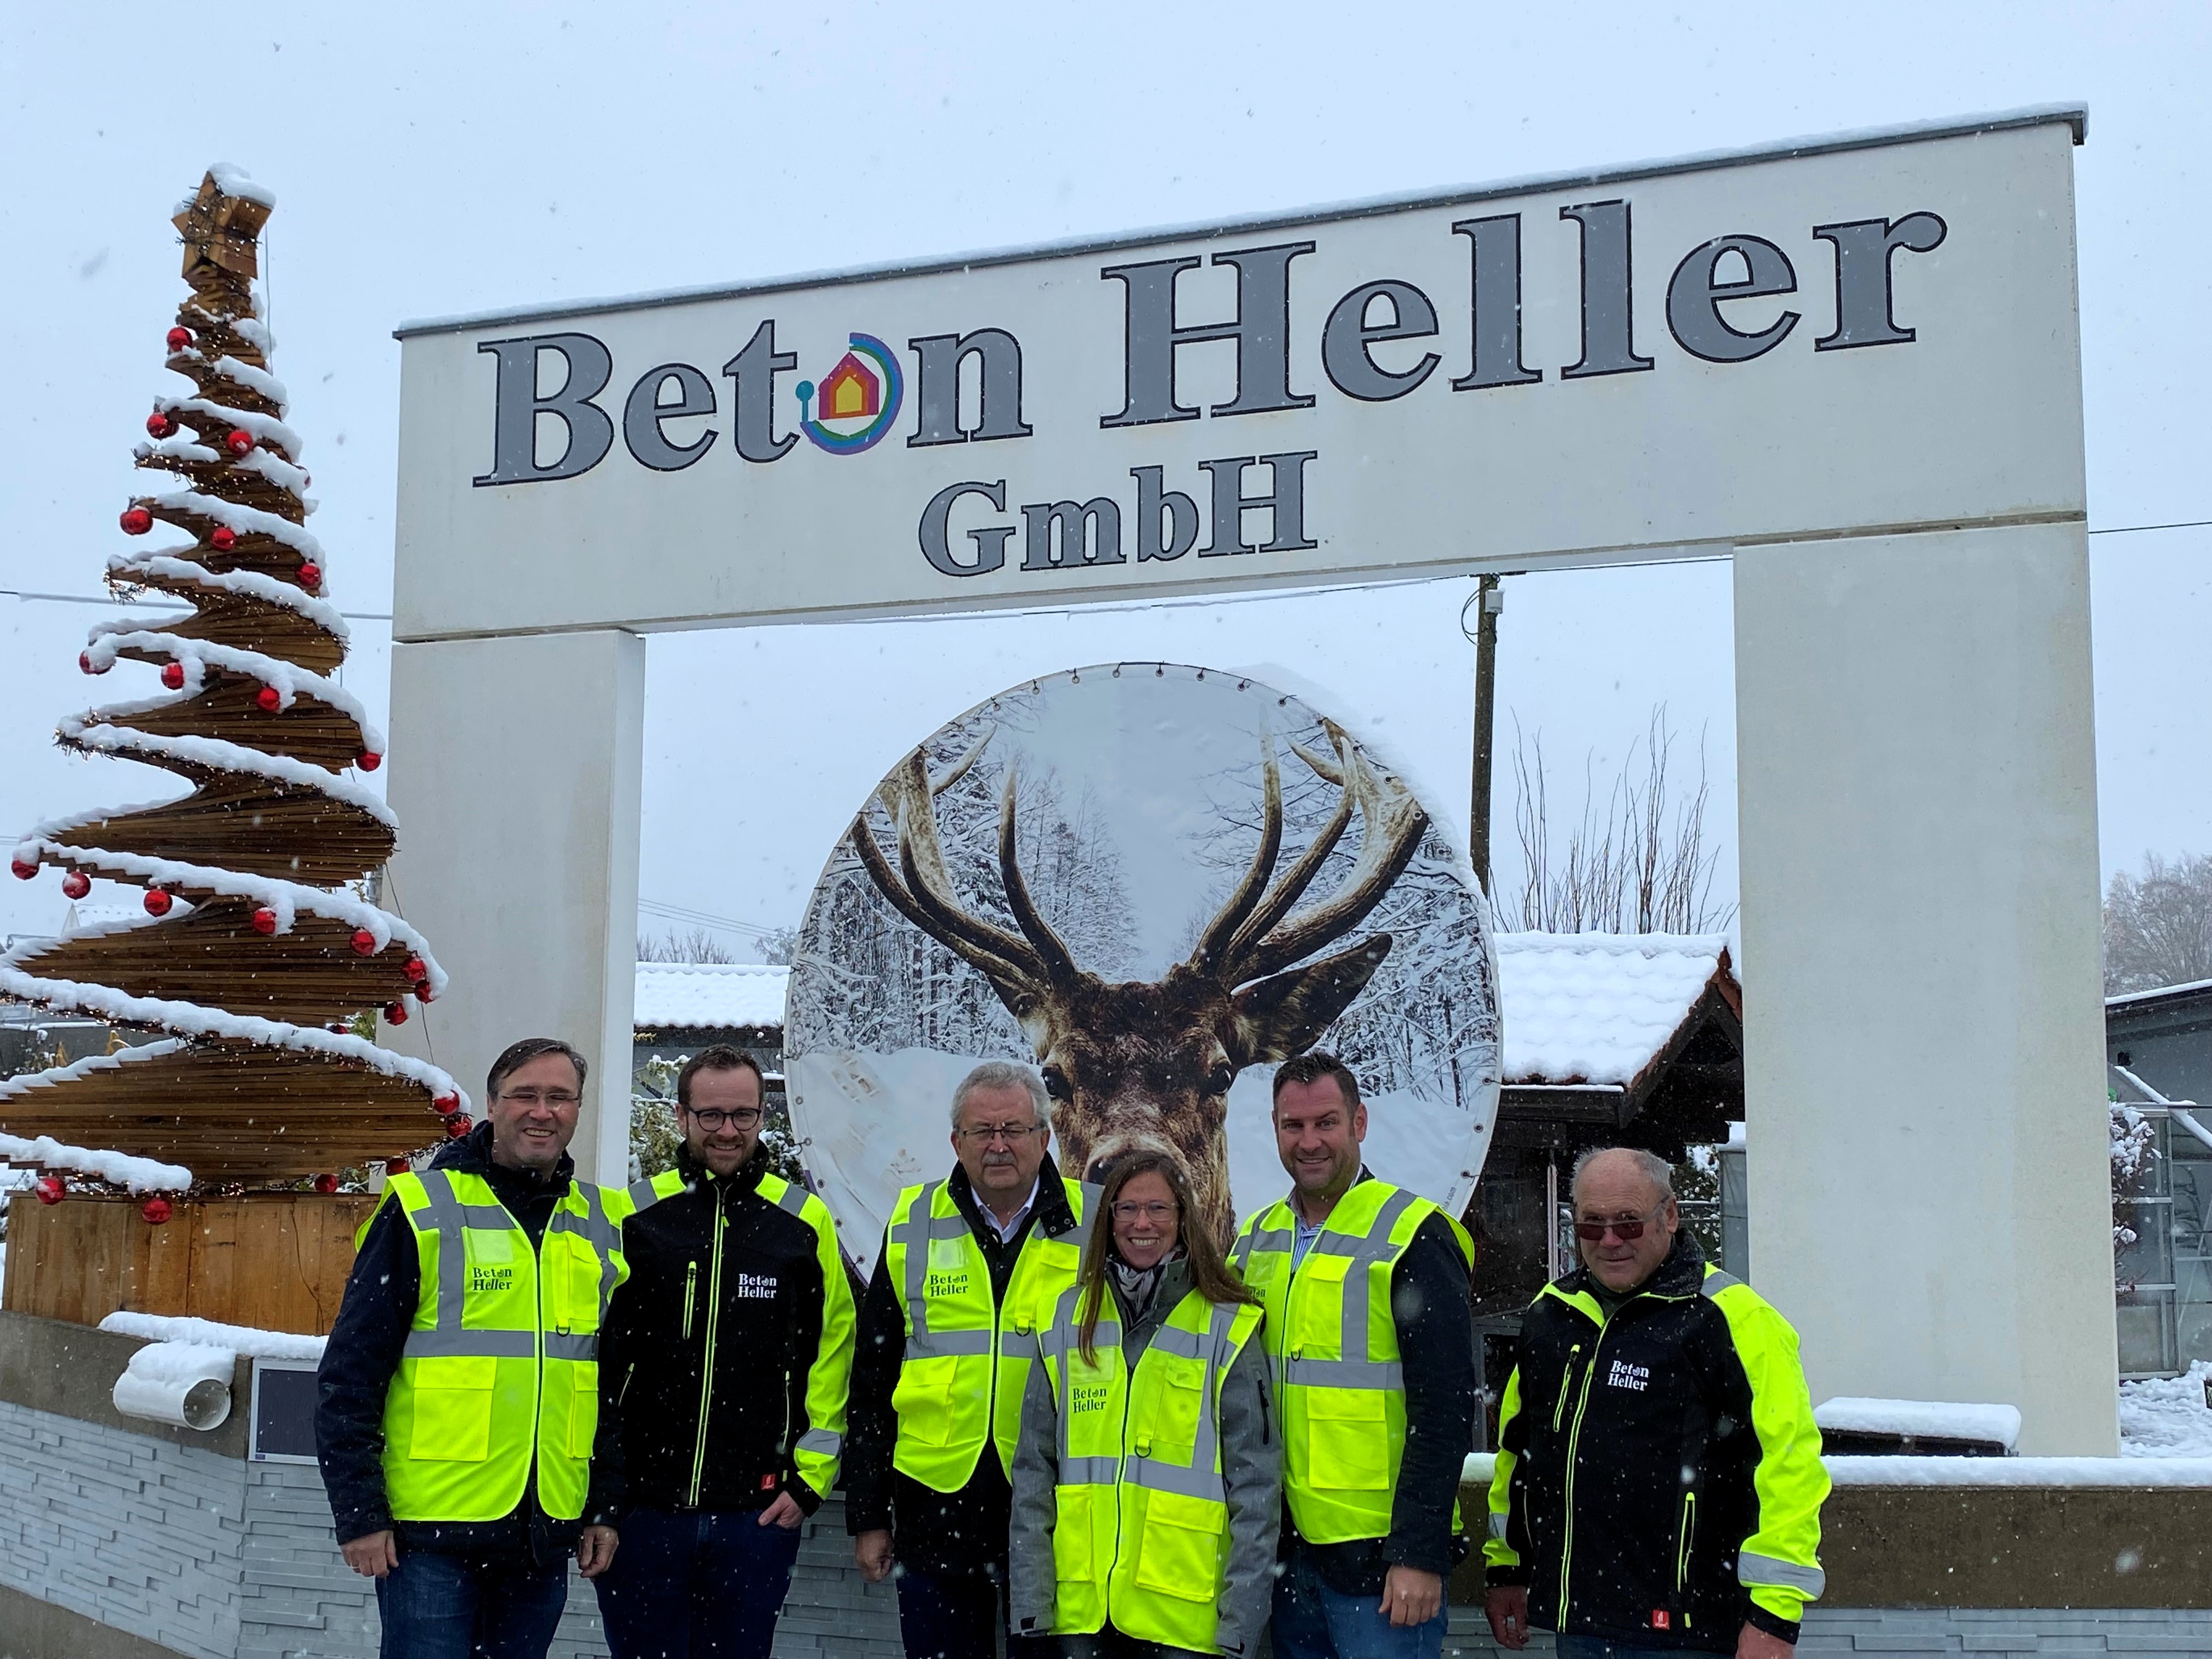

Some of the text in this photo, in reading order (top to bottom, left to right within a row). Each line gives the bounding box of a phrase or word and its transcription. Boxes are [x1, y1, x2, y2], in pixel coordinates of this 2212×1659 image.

[473, 199, 1948, 487] Beton Heller
[918, 450, 1318, 577] GmbH
[473, 1267, 512, 1278] Beton
[473, 1279, 513, 1291] Heller
[738, 1273, 777, 1286] Beton
[930, 1274, 968, 1285] Beton
[738, 1286, 777, 1299] Heller
[930, 1284, 969, 1297] Heller
[1610, 1360, 1649, 1378] Beton
[1607, 1373, 1648, 1391] Heller
[1073, 1387, 1107, 1400] Beton
[1073, 1399, 1107, 1413] Heller
